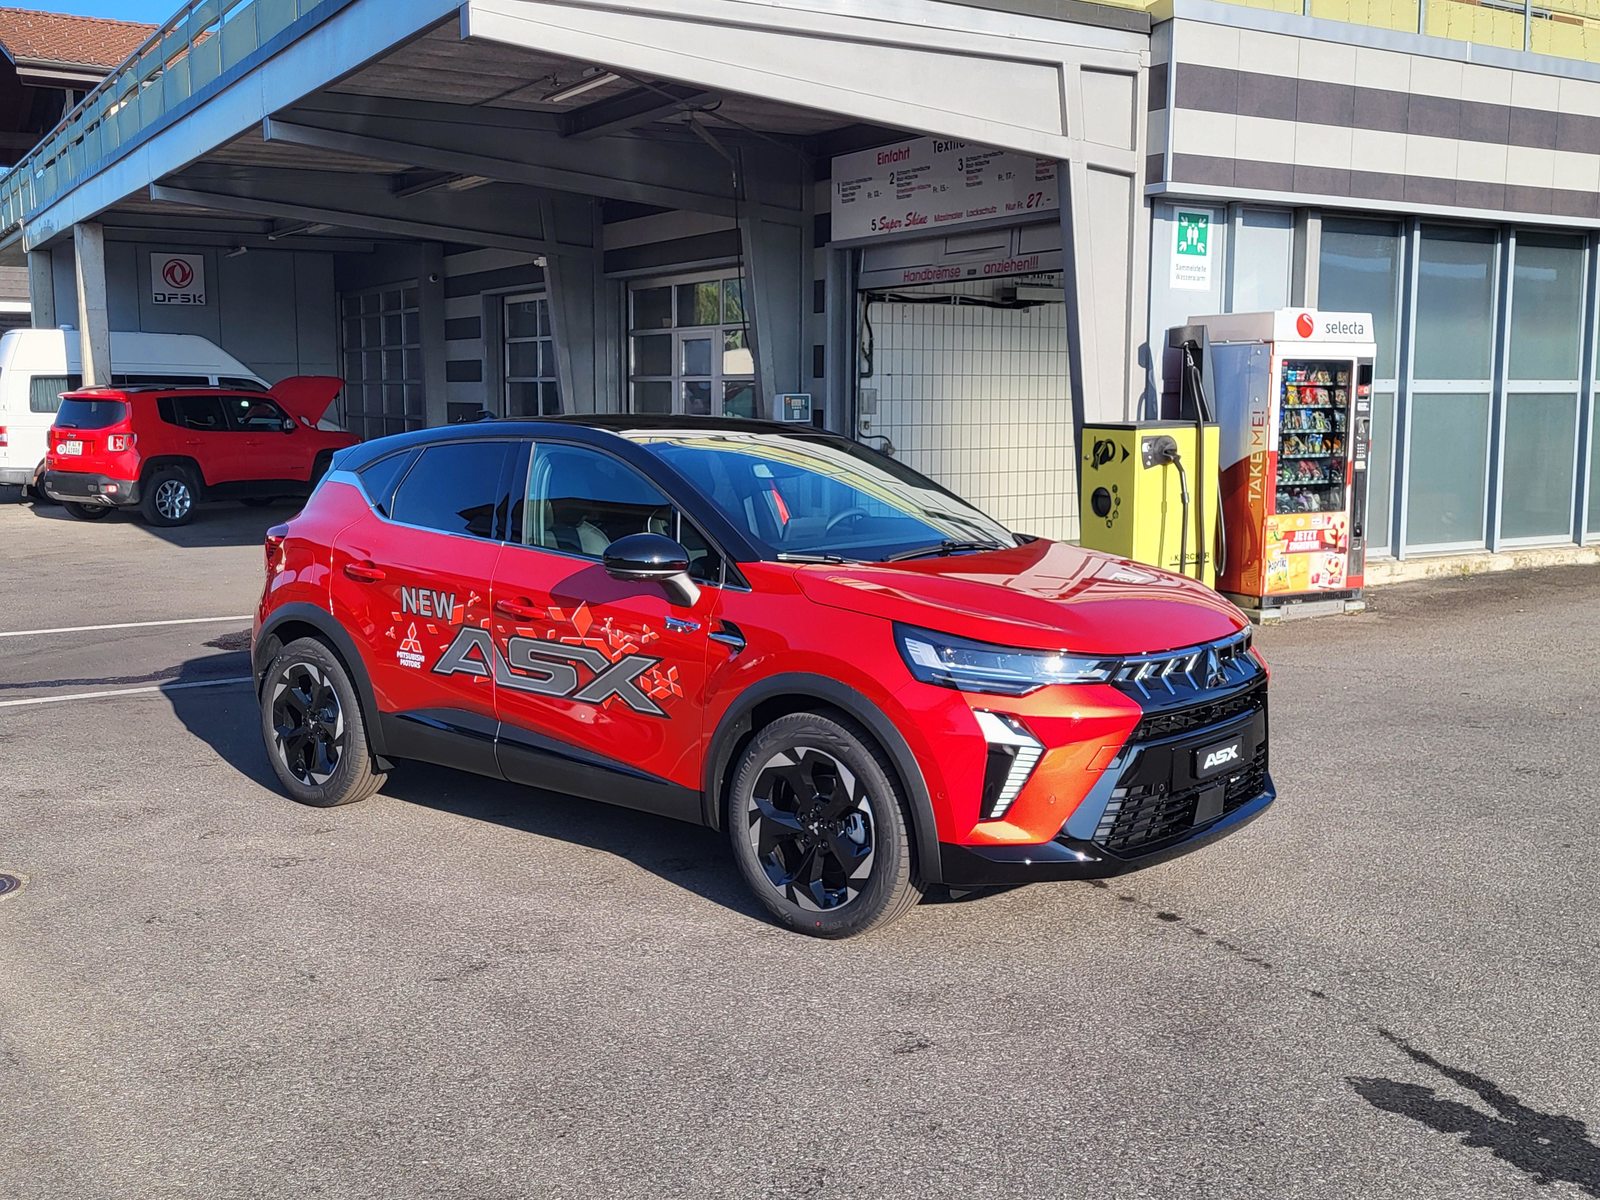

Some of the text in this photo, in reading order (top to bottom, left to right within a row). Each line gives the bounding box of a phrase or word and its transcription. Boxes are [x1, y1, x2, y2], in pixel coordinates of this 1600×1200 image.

[877, 146, 910, 165] Einfahrt
[958, 158, 963, 172] 3
[889, 172, 895, 184] 2
[871, 219, 877, 231] 5
[878, 216, 902, 232] Super
[904, 212, 928, 227] Shine
[903, 255, 1039, 282] Handbremse anziehen!!!
[153, 292, 205, 304] DFSK
[1325, 321, 1364, 335] selecta
[1248, 410, 1265, 502] TAKE ME!
[1295, 530, 1318, 542] JETZT
[400, 585, 455, 621] NEW
[396, 650, 425, 663] MITSUBISHI
[400, 657, 421, 669] MOTORS
[431, 626, 672, 719] ASX
[1203, 744, 1239, 770] ASX
